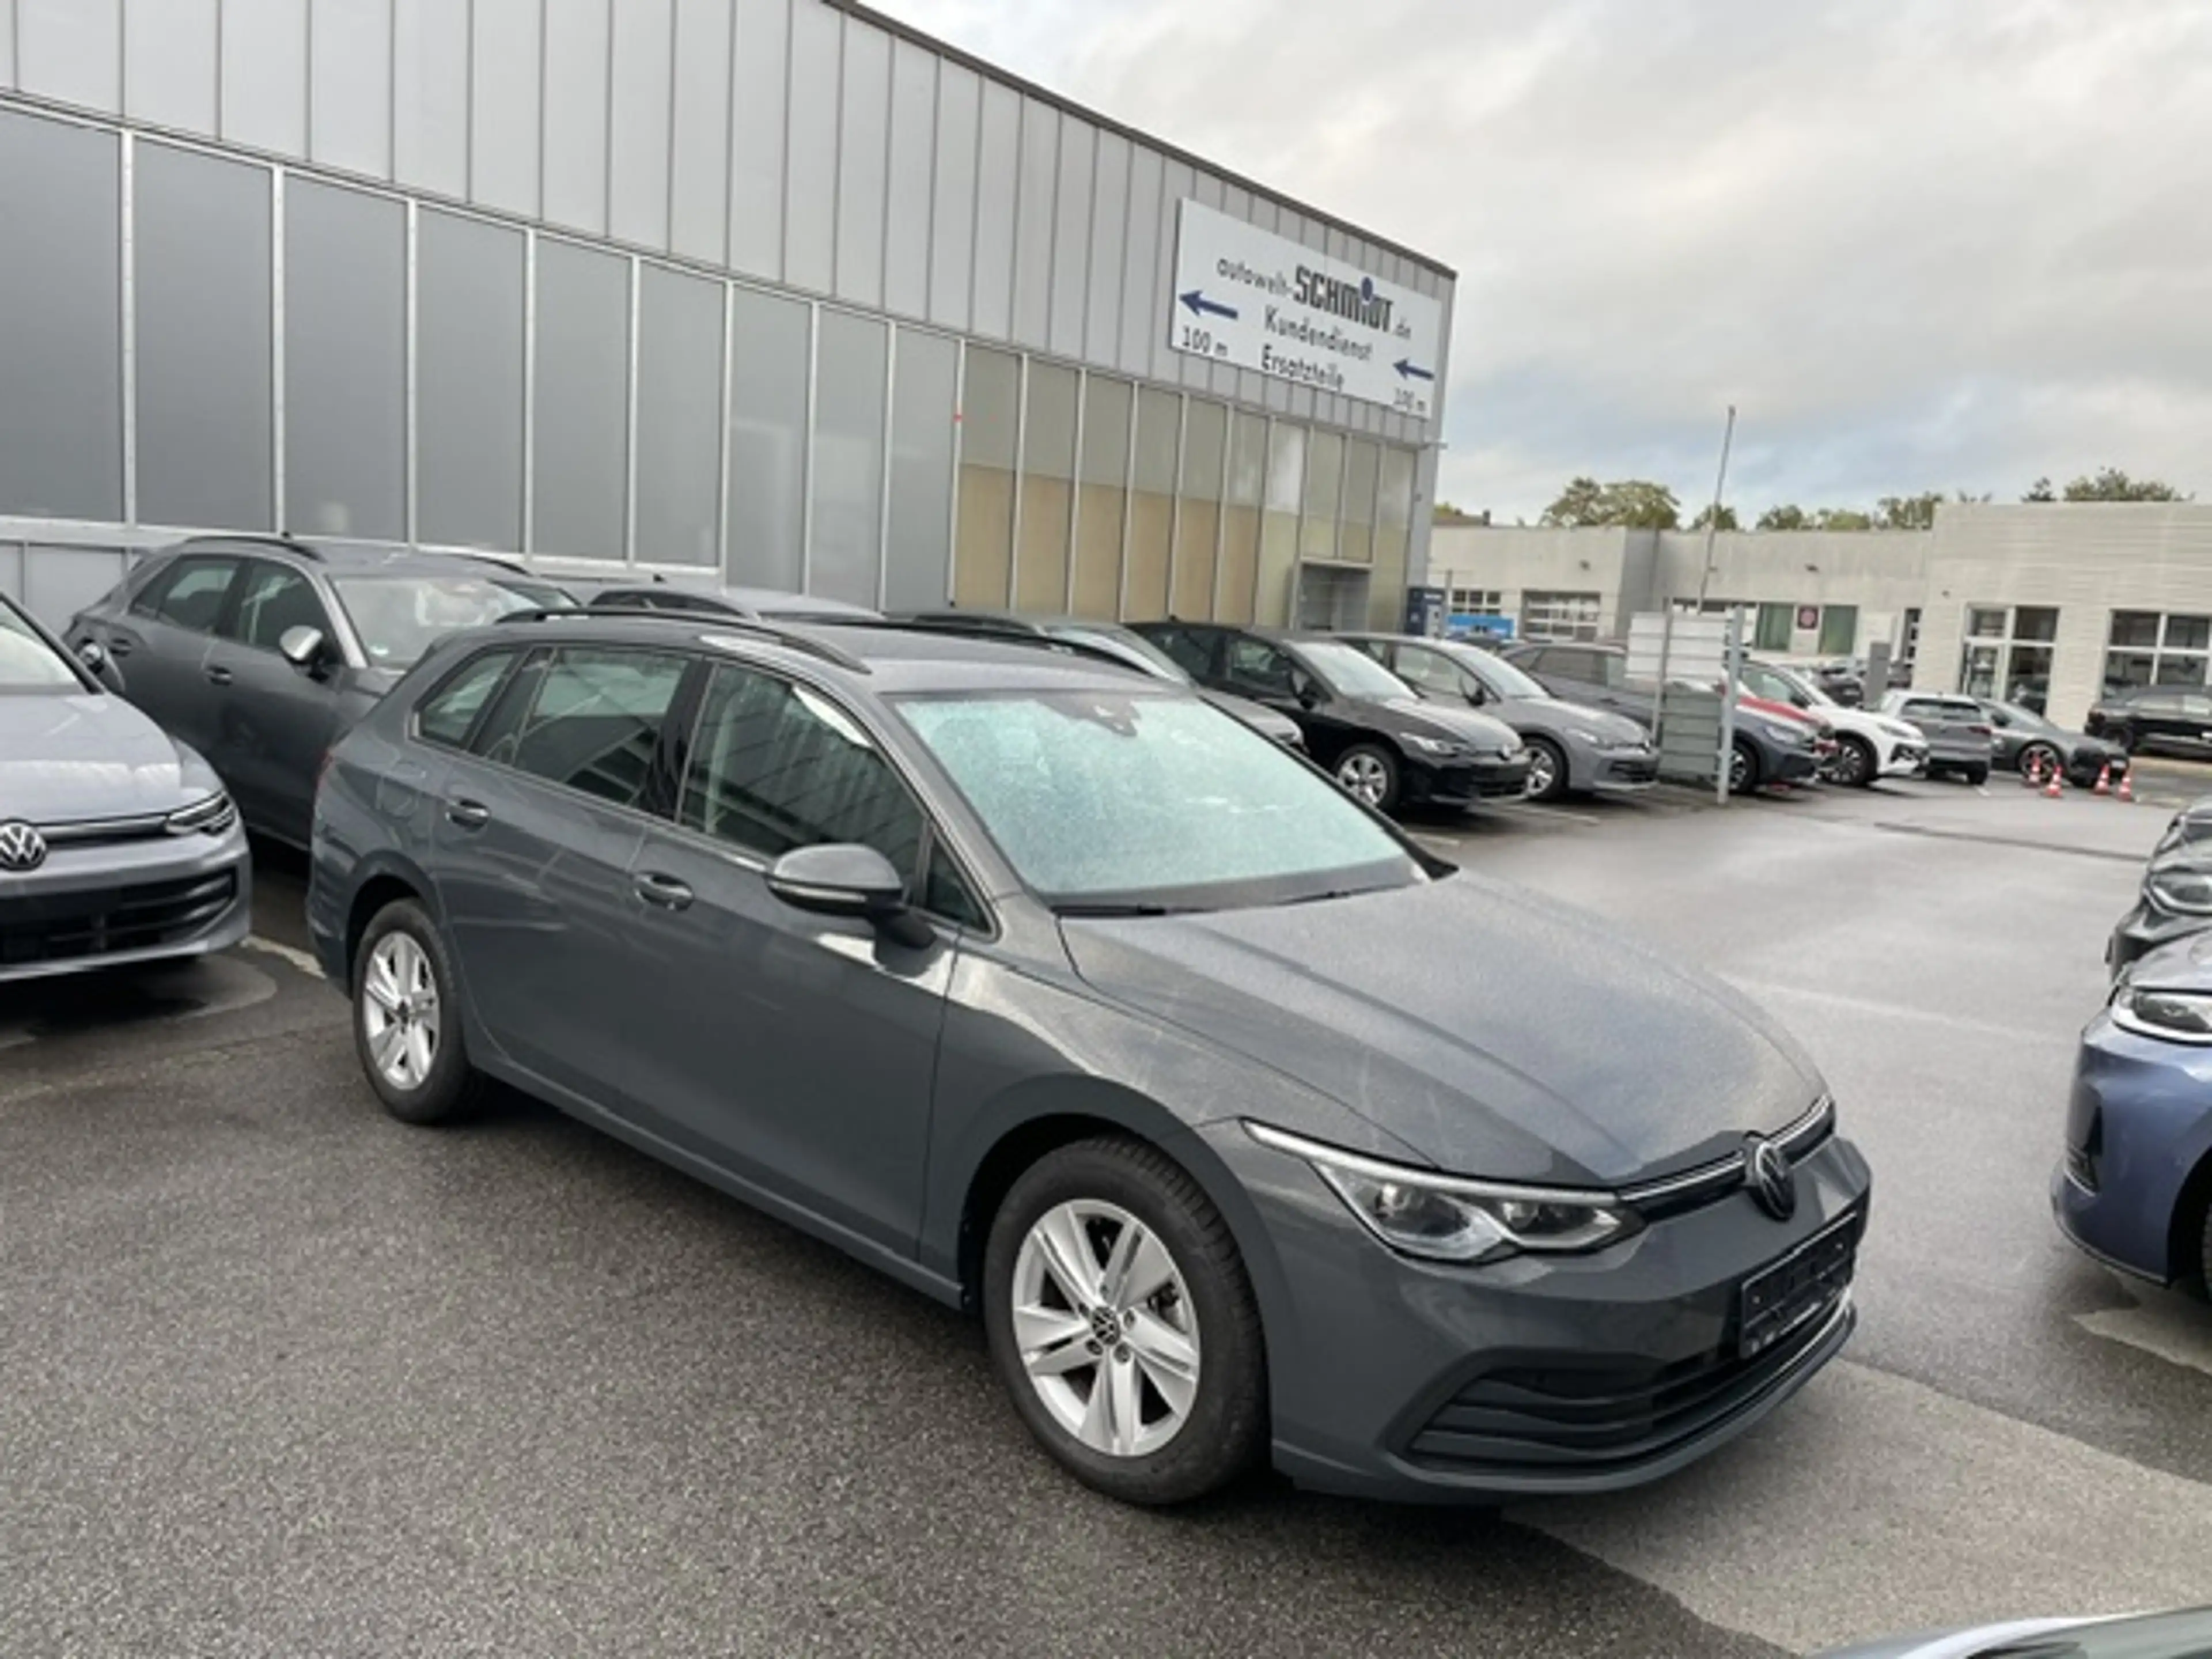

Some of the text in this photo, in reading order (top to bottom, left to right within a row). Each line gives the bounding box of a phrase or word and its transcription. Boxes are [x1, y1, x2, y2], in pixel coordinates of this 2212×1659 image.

[1182, 325, 1228, 356] 100 m
[1264, 307, 1373, 361] Kundendienst
[1262, 344, 1344, 392] Ersatzteile
